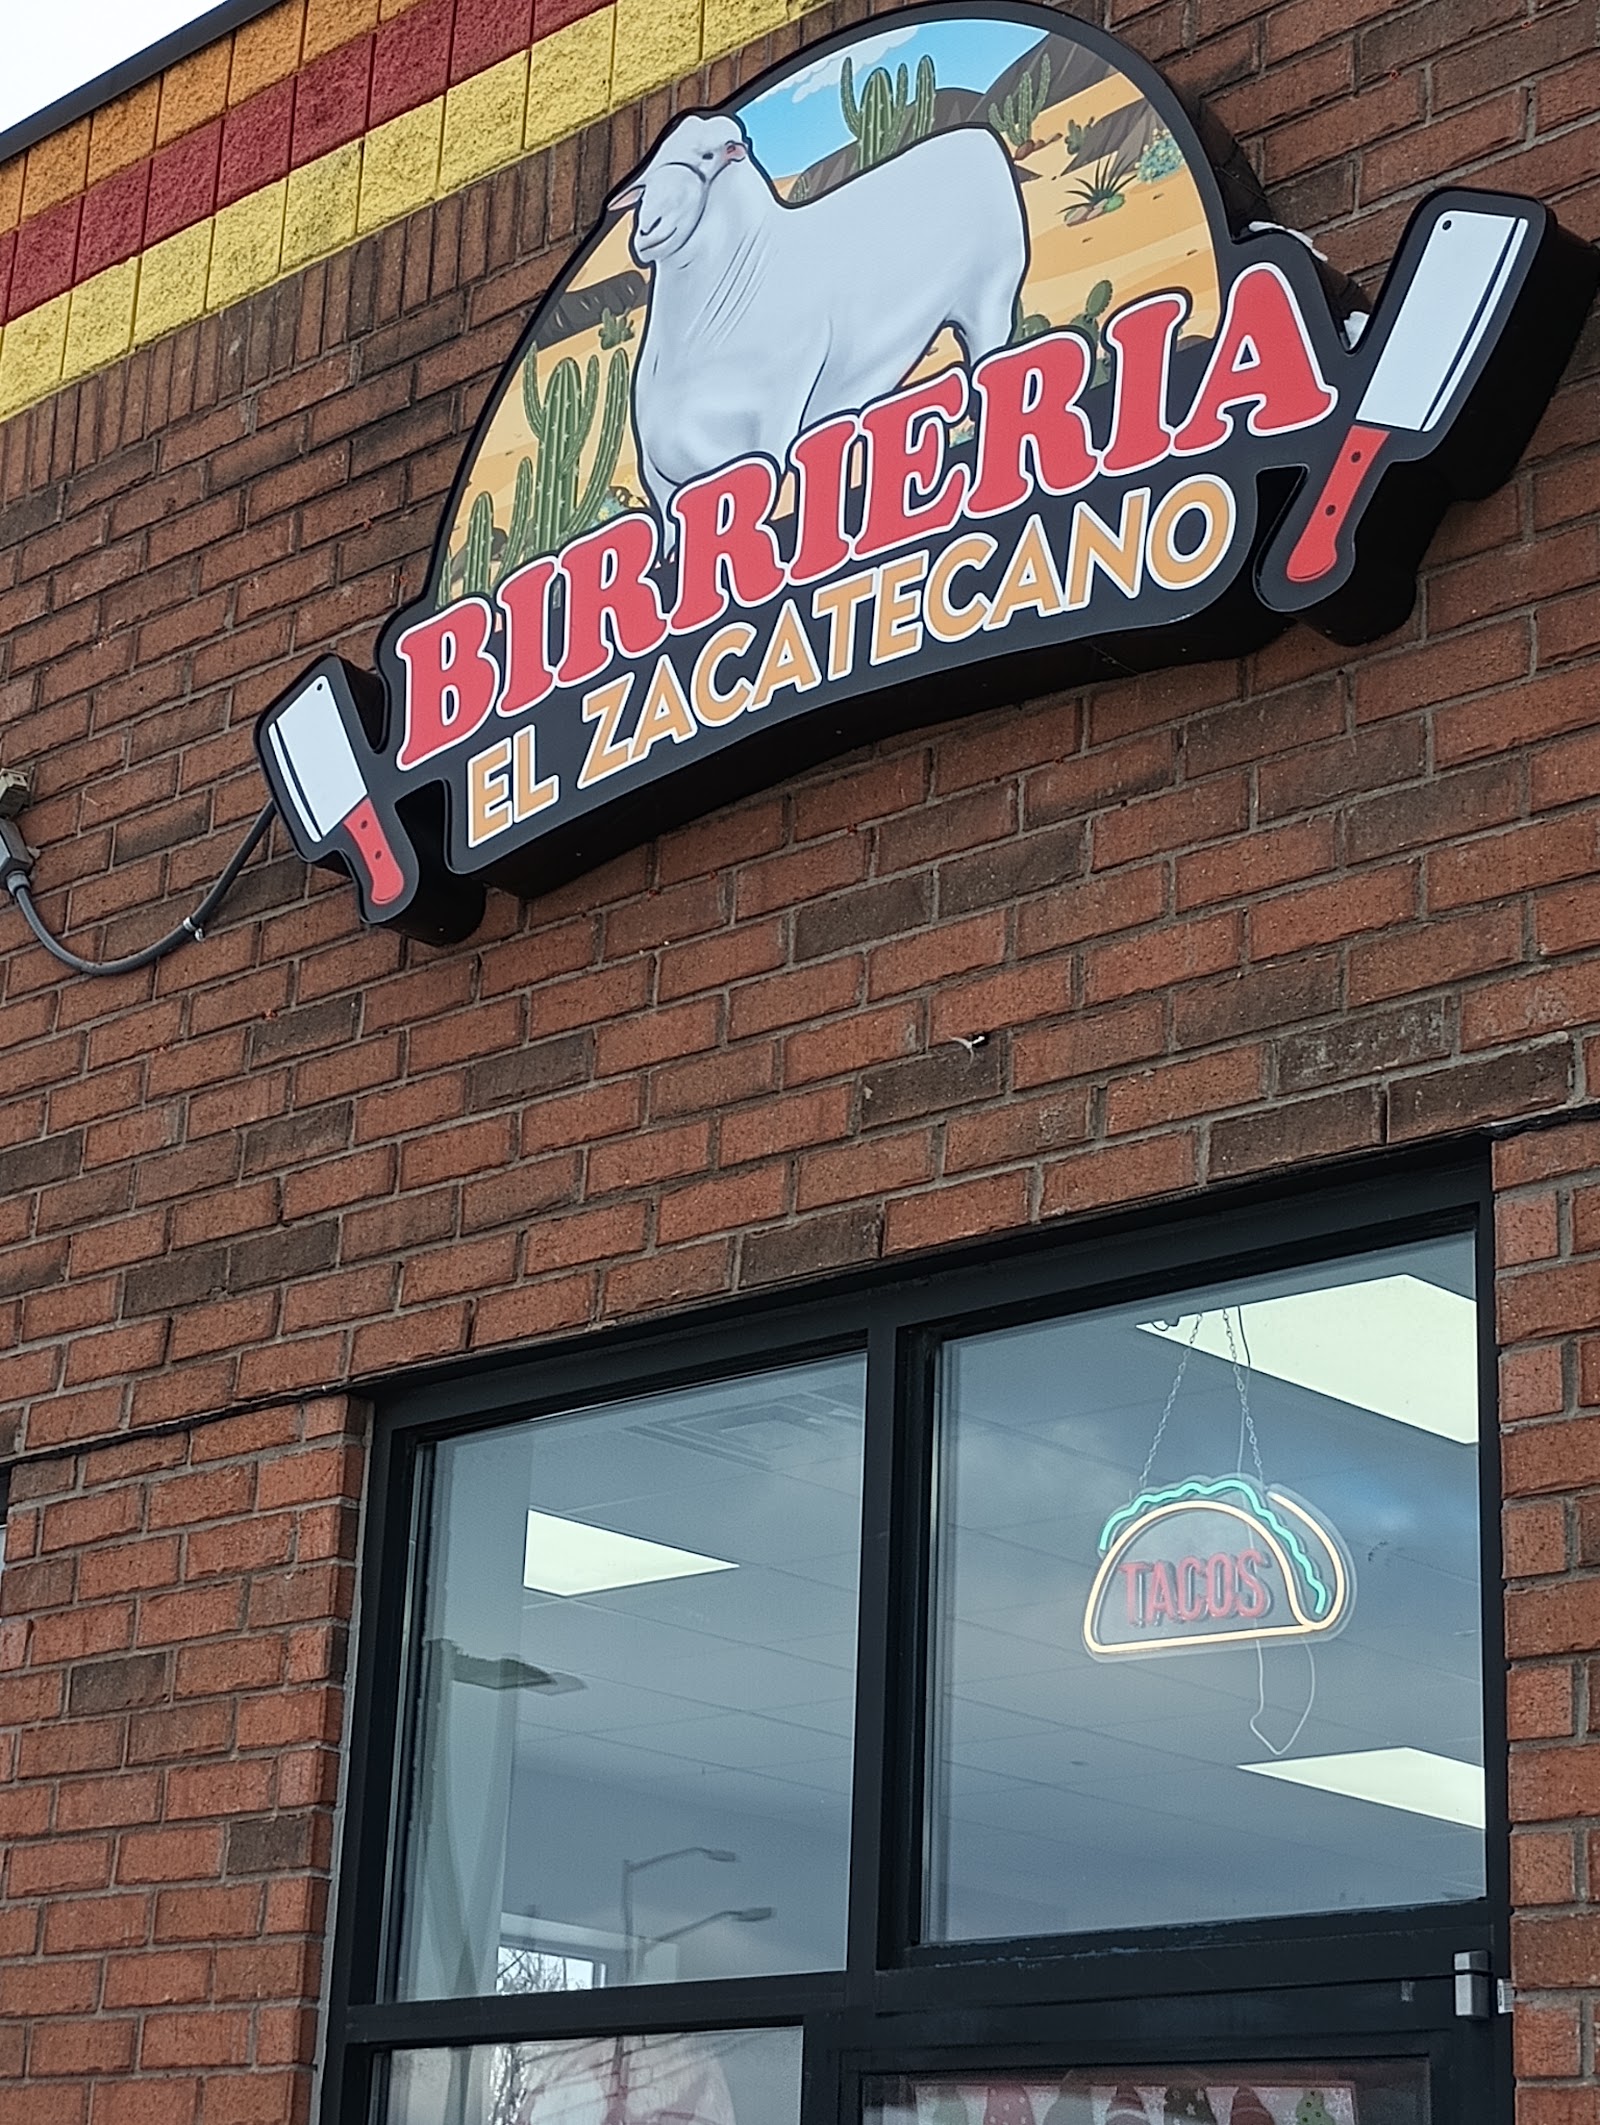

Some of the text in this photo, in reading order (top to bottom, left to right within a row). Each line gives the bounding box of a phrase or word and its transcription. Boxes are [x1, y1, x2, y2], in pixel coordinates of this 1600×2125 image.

[396, 261, 1338, 772] BIRRIERIA
[466, 473, 1239, 850] EL ZACATECANO
[1120, 1549, 1268, 1625] TACOS
